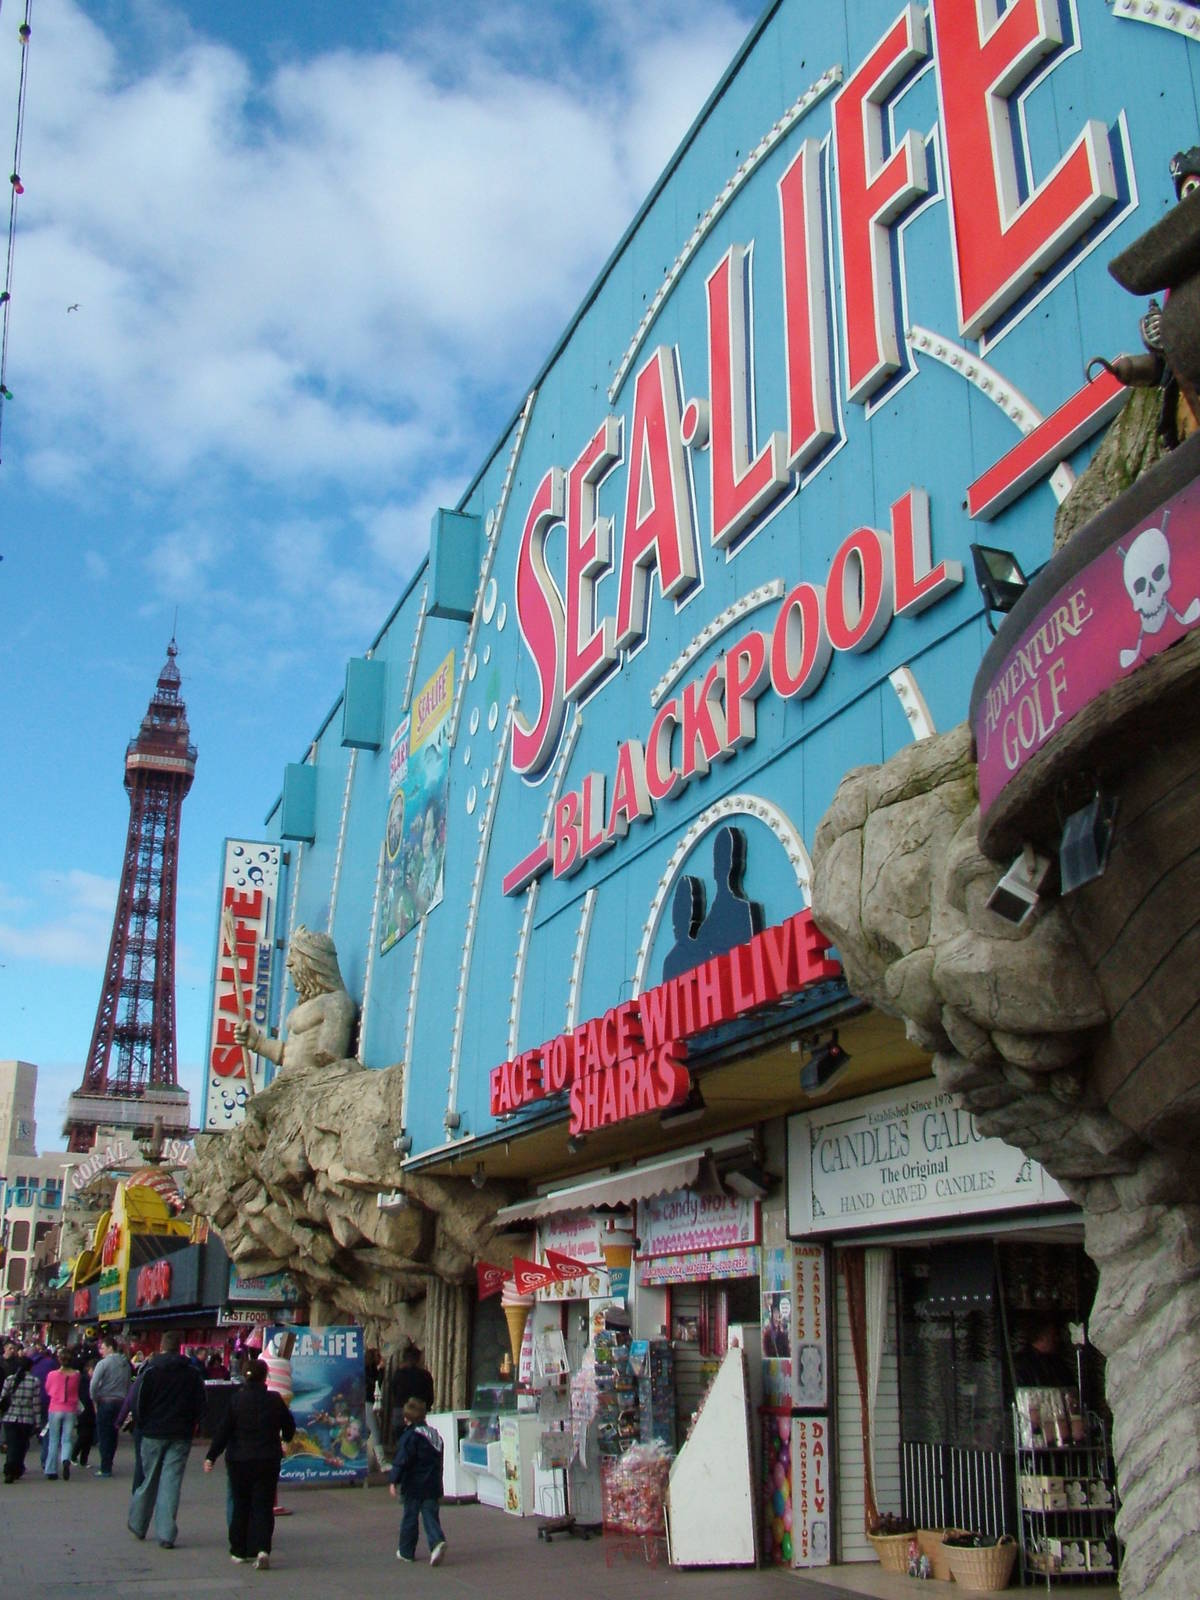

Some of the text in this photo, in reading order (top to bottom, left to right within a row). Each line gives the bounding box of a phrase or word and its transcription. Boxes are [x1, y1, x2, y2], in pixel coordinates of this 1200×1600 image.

[553, 486, 963, 880] BLACKPOOL
[982, 588, 1093, 761] ADVENTURE
[1002, 657, 1068, 771] GOLF
[255, 943, 271, 1026] CENTRE
[490, 906, 842, 1116] FACE TO FACE WITH LIVE
[569, 1042, 690, 1136] SHARKS
[868, 1105, 909, 1125] Established
[911, 1099, 933, 1113] Since
[71, 1137, 191, 1190] CORAL ISL
[820, 1118, 910, 1174] CANDLES
[880, 1156, 949, 1184] The Original
[663, 1189, 698, 1226] candy
[839, 1170, 996, 1213] HAND CARVED CANDLES
[795, 1247, 822, 1257] HAND
[224, 1310, 268, 1323] FAST FOOD
[812, 1260, 822, 1340] CANDLES
[279, 1468, 305, 1480] Caring
[305, 1467, 317, 1478] for
[799, 1421, 809, 1558] DEMONSTRATIONS
[811, 1422, 826, 1514] DAILY
